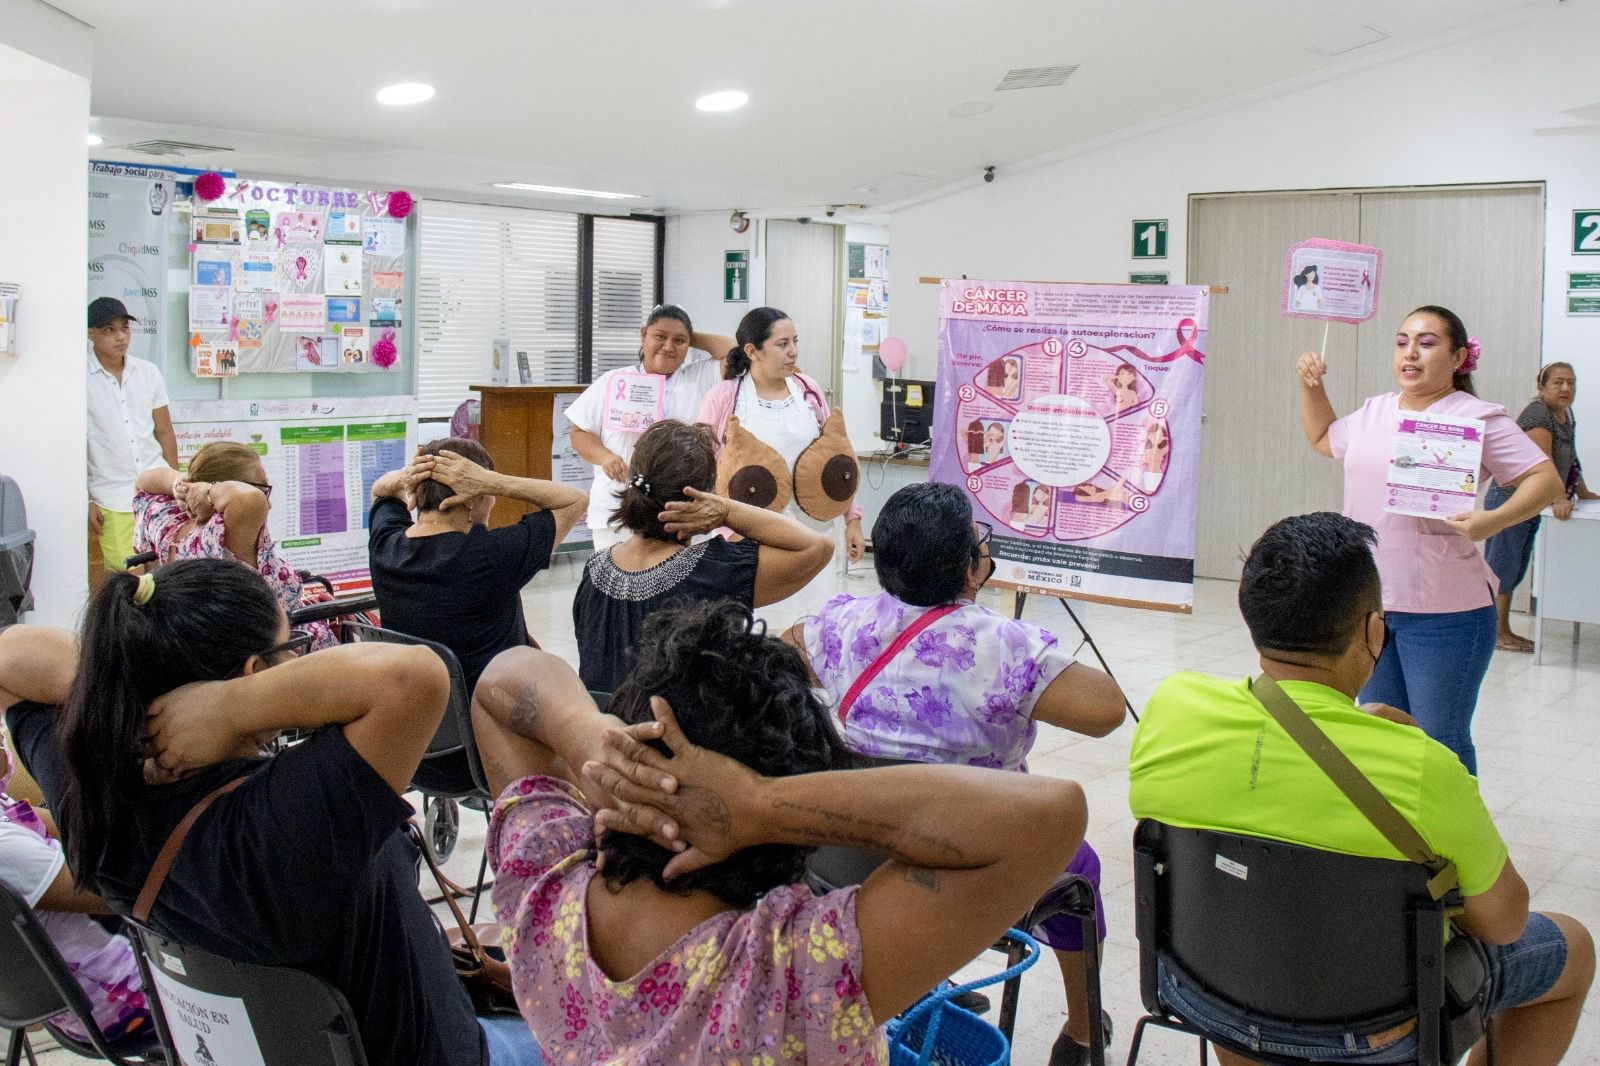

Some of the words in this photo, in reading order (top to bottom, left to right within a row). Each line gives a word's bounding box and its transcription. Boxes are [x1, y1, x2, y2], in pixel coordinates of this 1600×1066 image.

[92, 163, 122, 176] Trabajo
[124, 167, 147, 177] Social
[148, 171, 164, 179] para
[251, 186, 358, 208] OCTUBRE
[1579, 215, 1600, 249] 2
[1141, 225, 1156, 255] 1
[964, 287, 1027, 302] CÁNCER
[953, 301, 975, 313] DE
[977, 303, 1027, 316] MAMA
[982, 324, 1011, 333] ¿Cómo
[1026, 326, 1058, 335] realiza
[1071, 329, 1156, 341] autoexploración?
[1048, 341, 1057, 353] 1
[1069, 341, 1083, 354] 4
[1144, 364, 1171, 373] Toque:
[962, 387, 973, 399] 2
[1028, 404, 1096, 417] Recomendaciones
[1153, 401, 1165, 415] 5
[970, 478, 979, 490] 3
[1132, 497, 1146, 510] 6
[999, 550, 1031, 561] Recuerda:
[1052, 557, 1067, 565] vale
[1068, 560, 1100, 570] prevenir!
[1028, 574, 1062, 584] MÉXICO
[211, 1011, 230, 1025] EN
